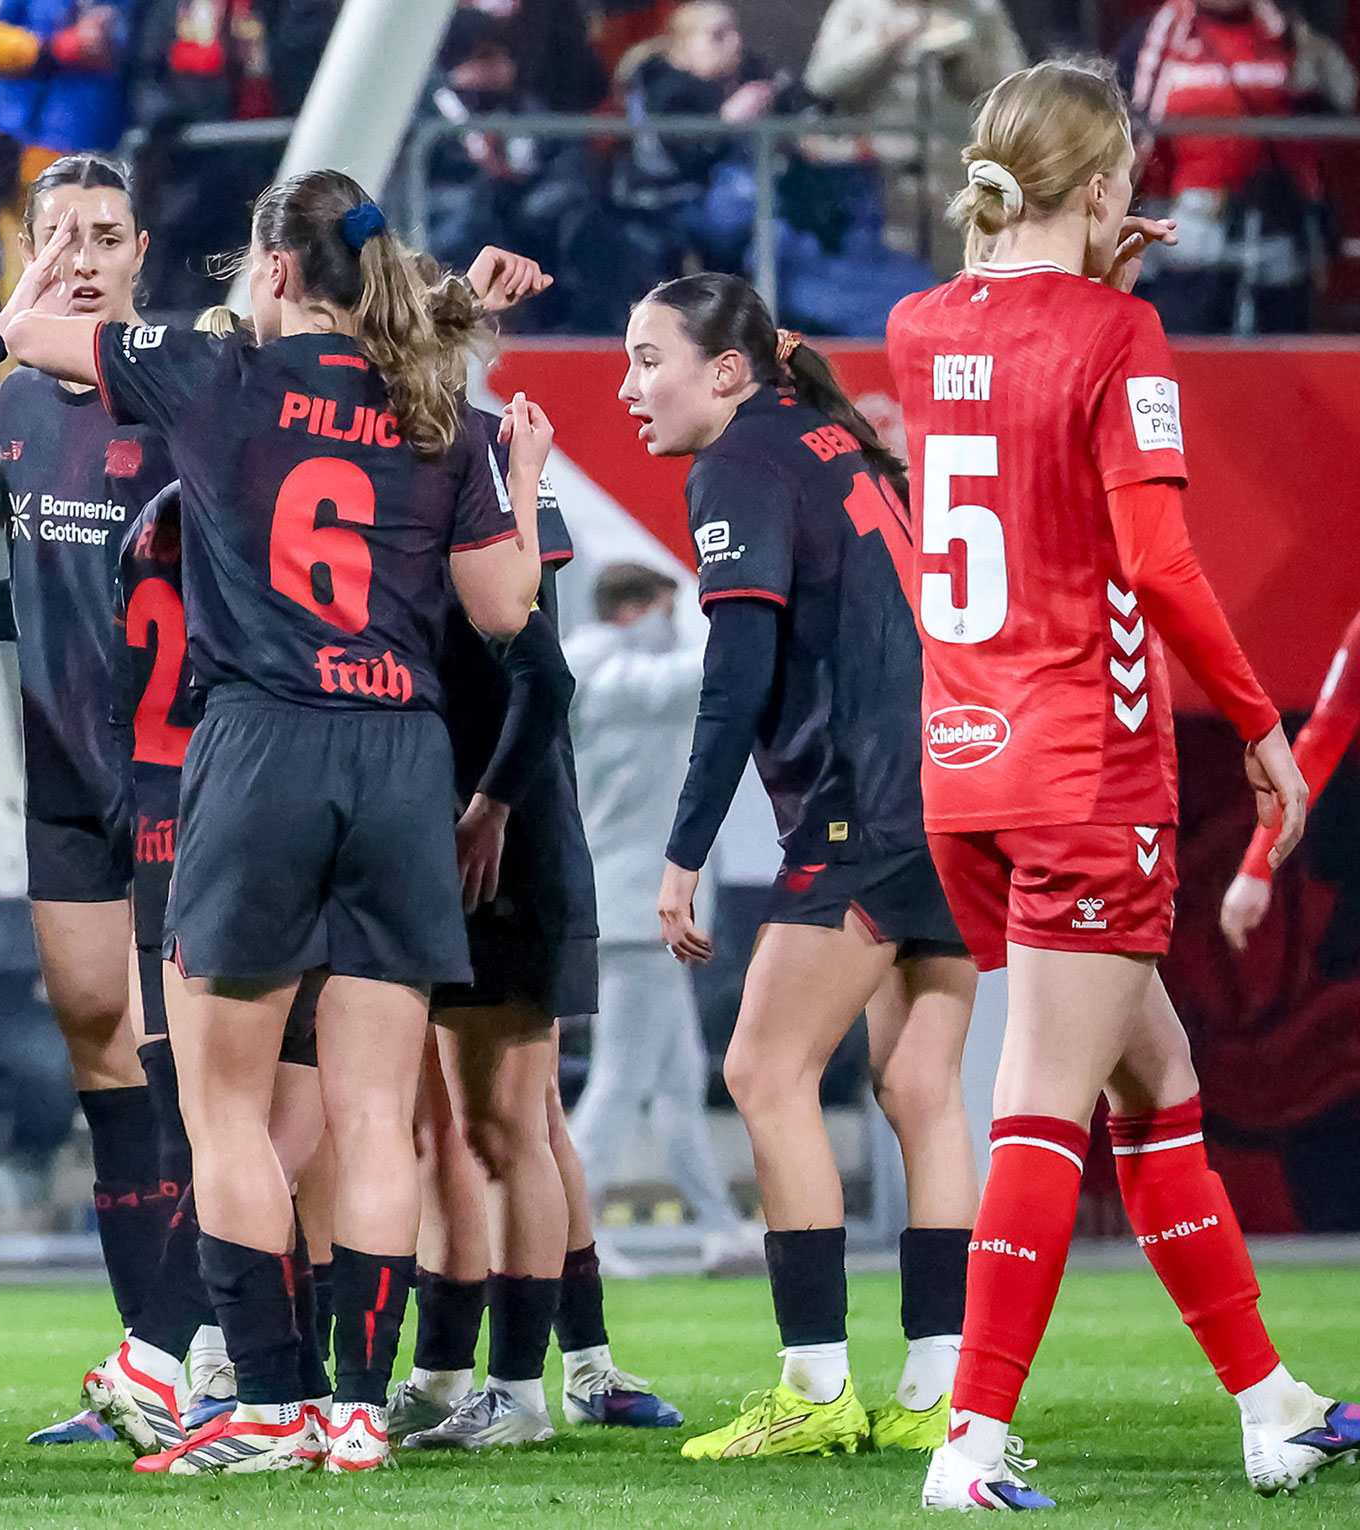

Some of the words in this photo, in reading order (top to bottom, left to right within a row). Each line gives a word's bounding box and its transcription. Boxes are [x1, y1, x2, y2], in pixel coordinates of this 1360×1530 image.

[933, 354, 994, 401] DEGEN
[40, 494, 127, 522] Barmenia
[40, 520, 110, 545] Gothaer
[269, 456, 376, 634] 6
[920, 434, 1009, 645] 5
[313, 645, 414, 704] früh
[929, 720, 997, 745] Schaebens
[135, 815, 176, 863] frü
[1160, 1214, 1219, 1241] KÖLN
[981, 1238, 1037, 1262] KÖLN
